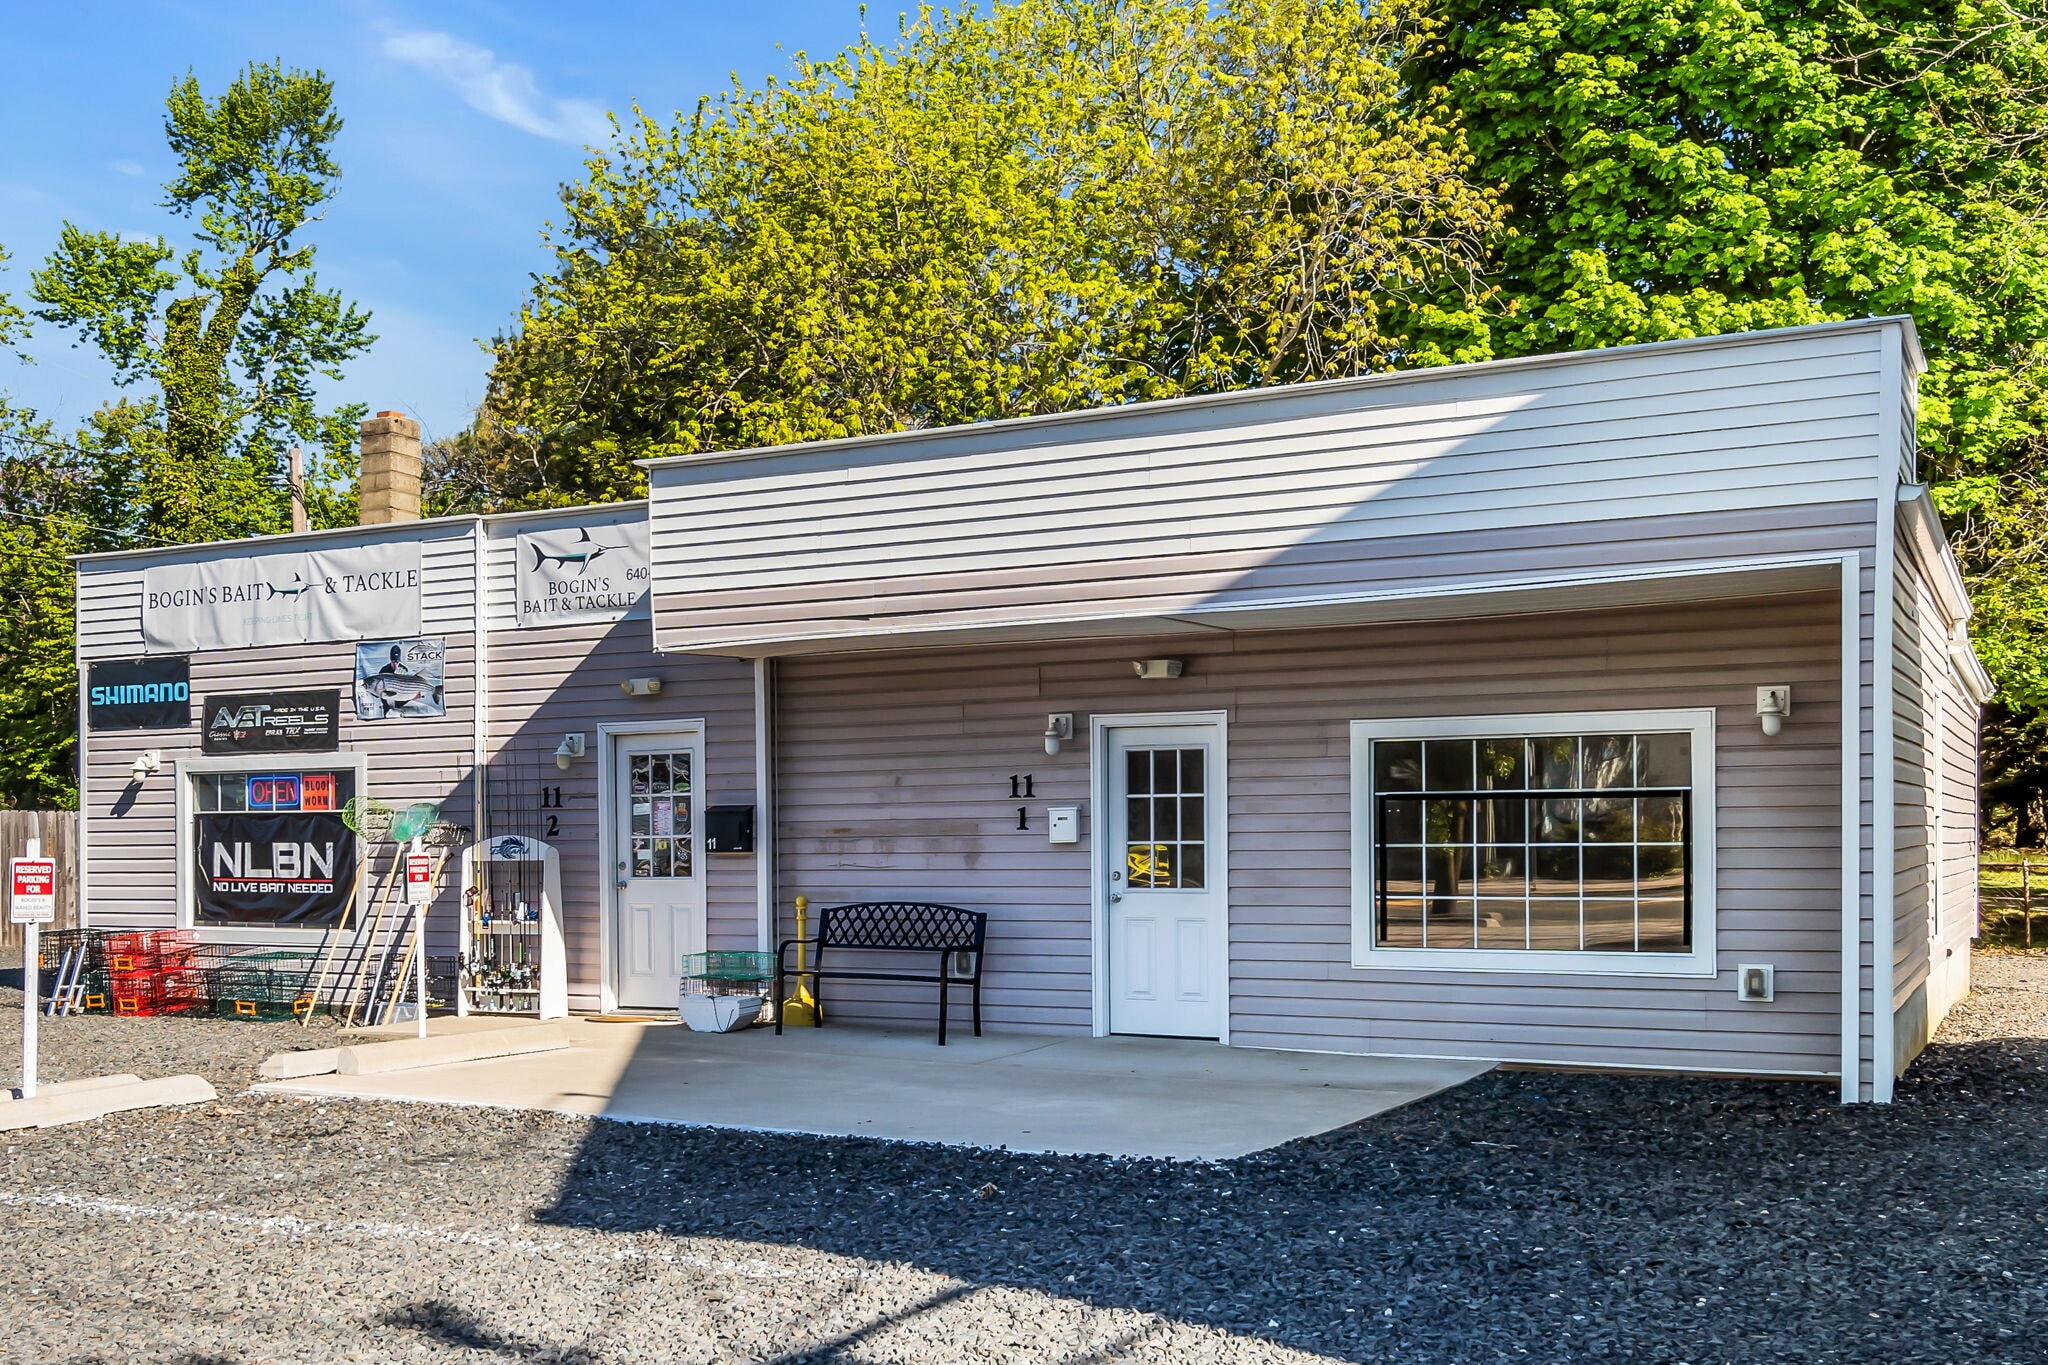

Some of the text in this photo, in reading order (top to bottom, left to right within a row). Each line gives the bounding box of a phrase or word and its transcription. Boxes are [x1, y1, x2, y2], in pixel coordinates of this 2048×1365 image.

[148, 569, 418, 609] BOGIN'S BAIT & TACKLE
[548, 577, 610, 596] BOGIN'S
[523, 592, 637, 614] BAIT & TACKLE
[407, 651, 442, 661] STACK
[91, 681, 189, 706] SHIMANO
[263, 713, 329, 727] REELS
[252, 781, 297, 803] OPEN
[541, 786, 564, 808] 11
[1008, 773, 1036, 799] 11
[546, 814, 560, 837] 2
[1016, 806, 1029, 831] 1
[707, 837, 717, 850] 11
[15, 865, 52, 874] RESERVED
[213, 841, 334, 879] NLBN
[17, 875, 50, 884] PARKING
[26, 885, 41, 894] FOR
[213, 882, 334, 894] NO LIVE BAIT NEEDED
